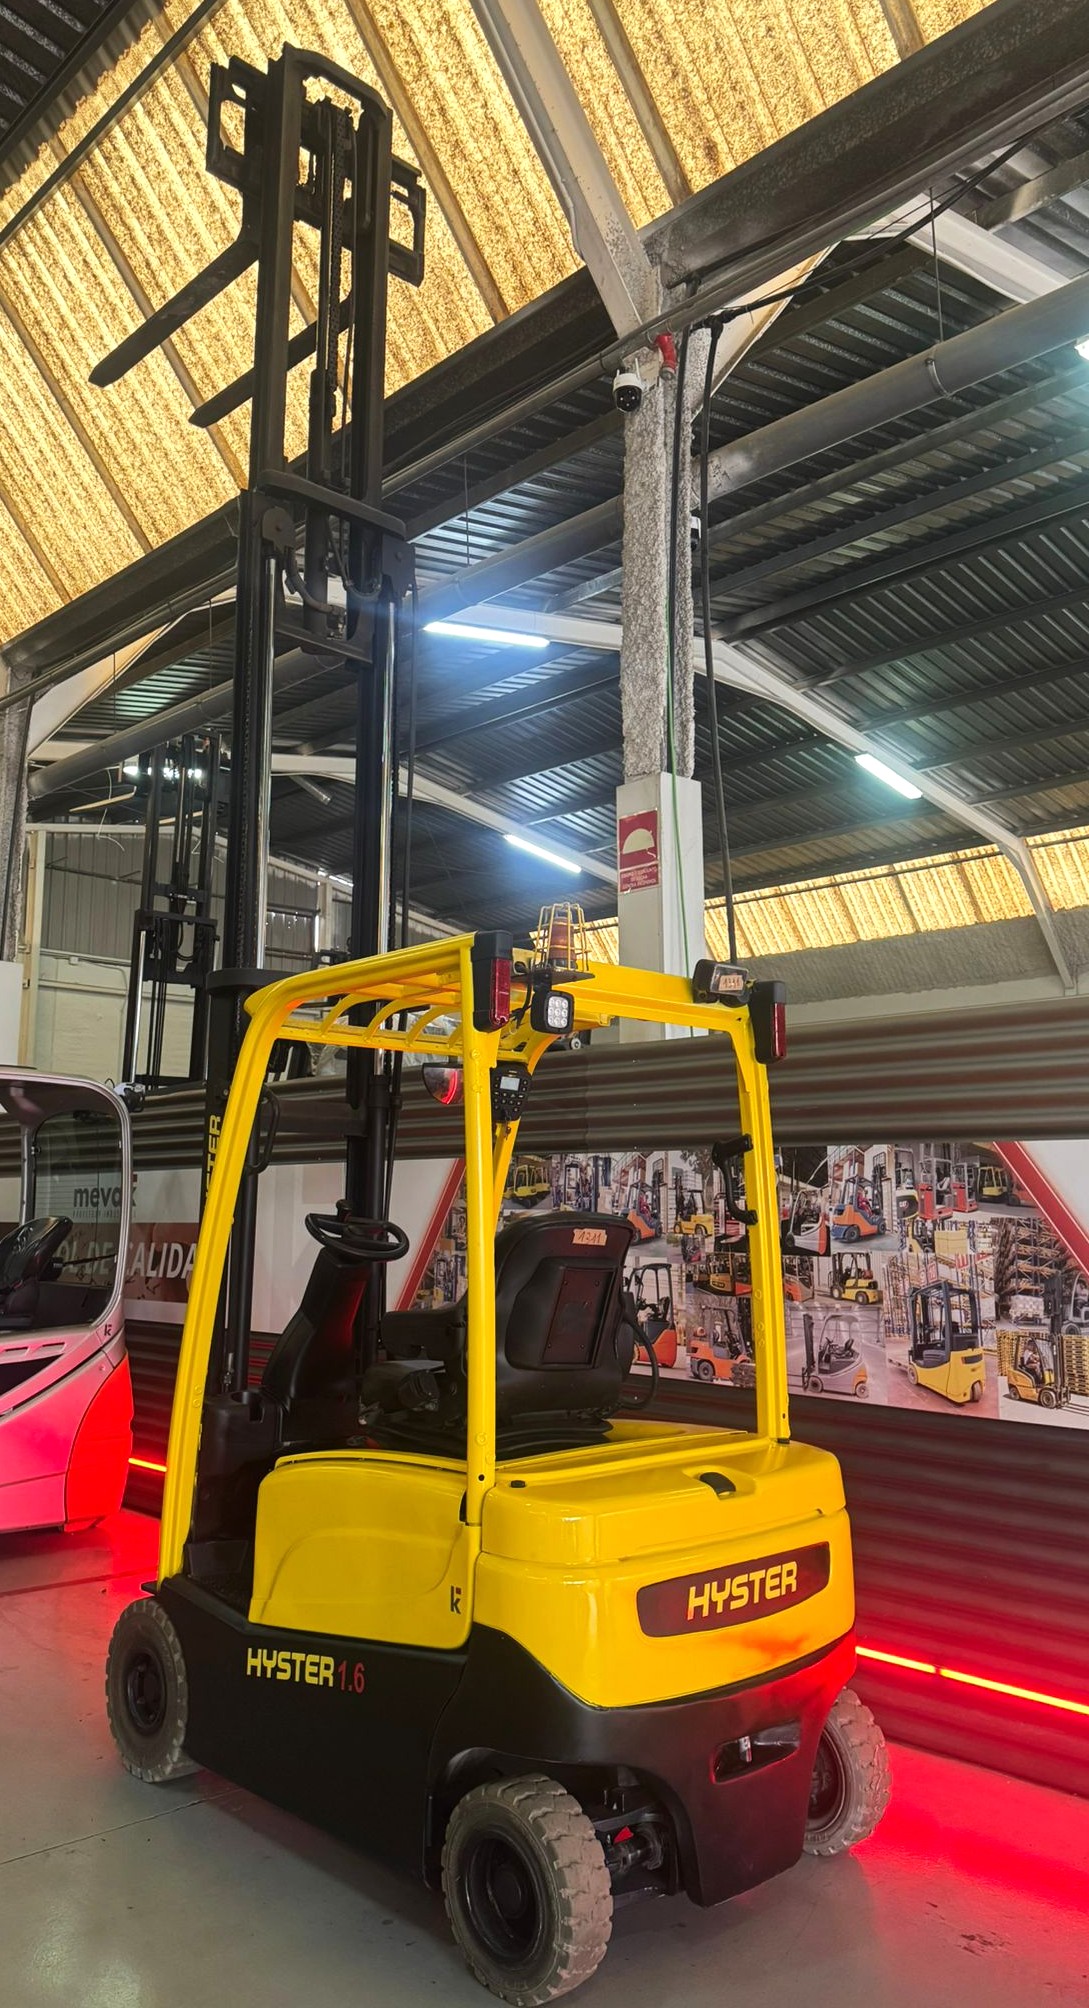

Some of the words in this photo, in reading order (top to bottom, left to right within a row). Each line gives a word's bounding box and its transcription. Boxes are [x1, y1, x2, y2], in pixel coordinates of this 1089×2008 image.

[687, 1561, 798, 1621] HYSTER
[246, 1648, 335, 1687] HYSTER
[337, 1660, 365, 1693] 1.6
